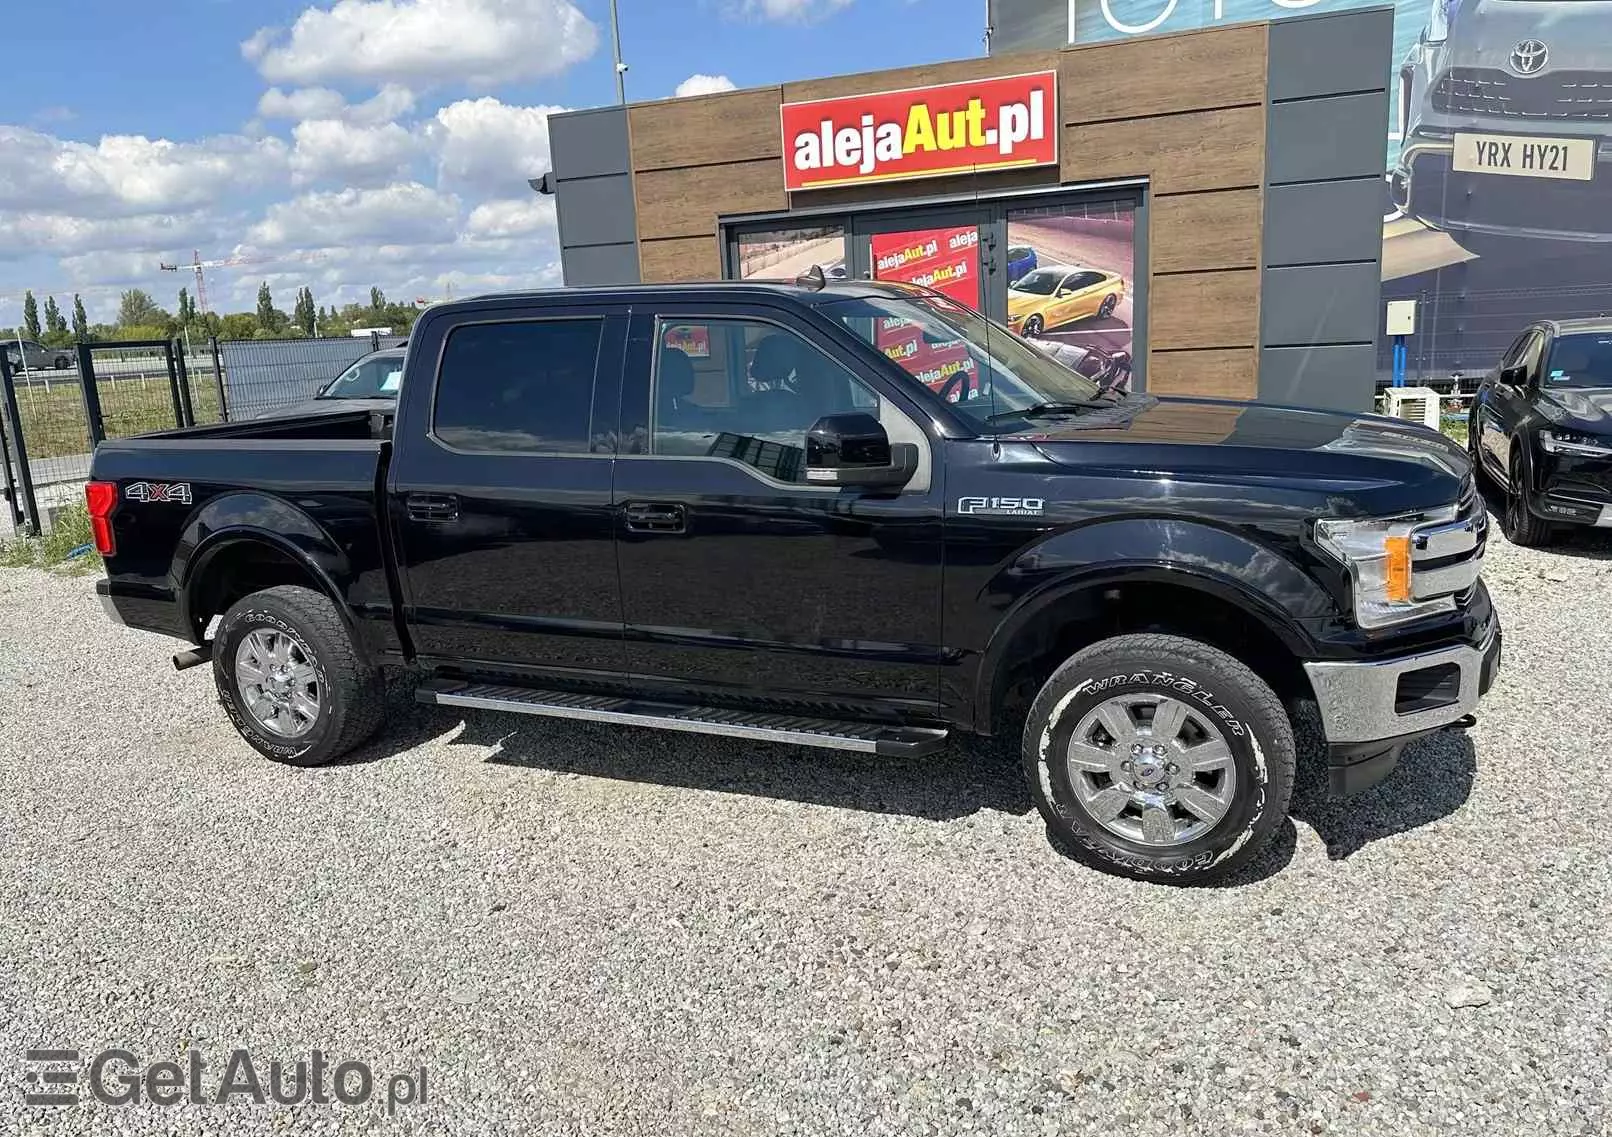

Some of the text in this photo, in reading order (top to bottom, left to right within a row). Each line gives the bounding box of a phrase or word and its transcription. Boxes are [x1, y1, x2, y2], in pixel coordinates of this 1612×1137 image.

[794, 90, 1045, 174] alejaAut.pl
[1476, 141, 1568, 171] YRX HY21
[877, 240, 938, 270] alejaAut.pl
[1082, 673, 1245, 737] WRANGLER
